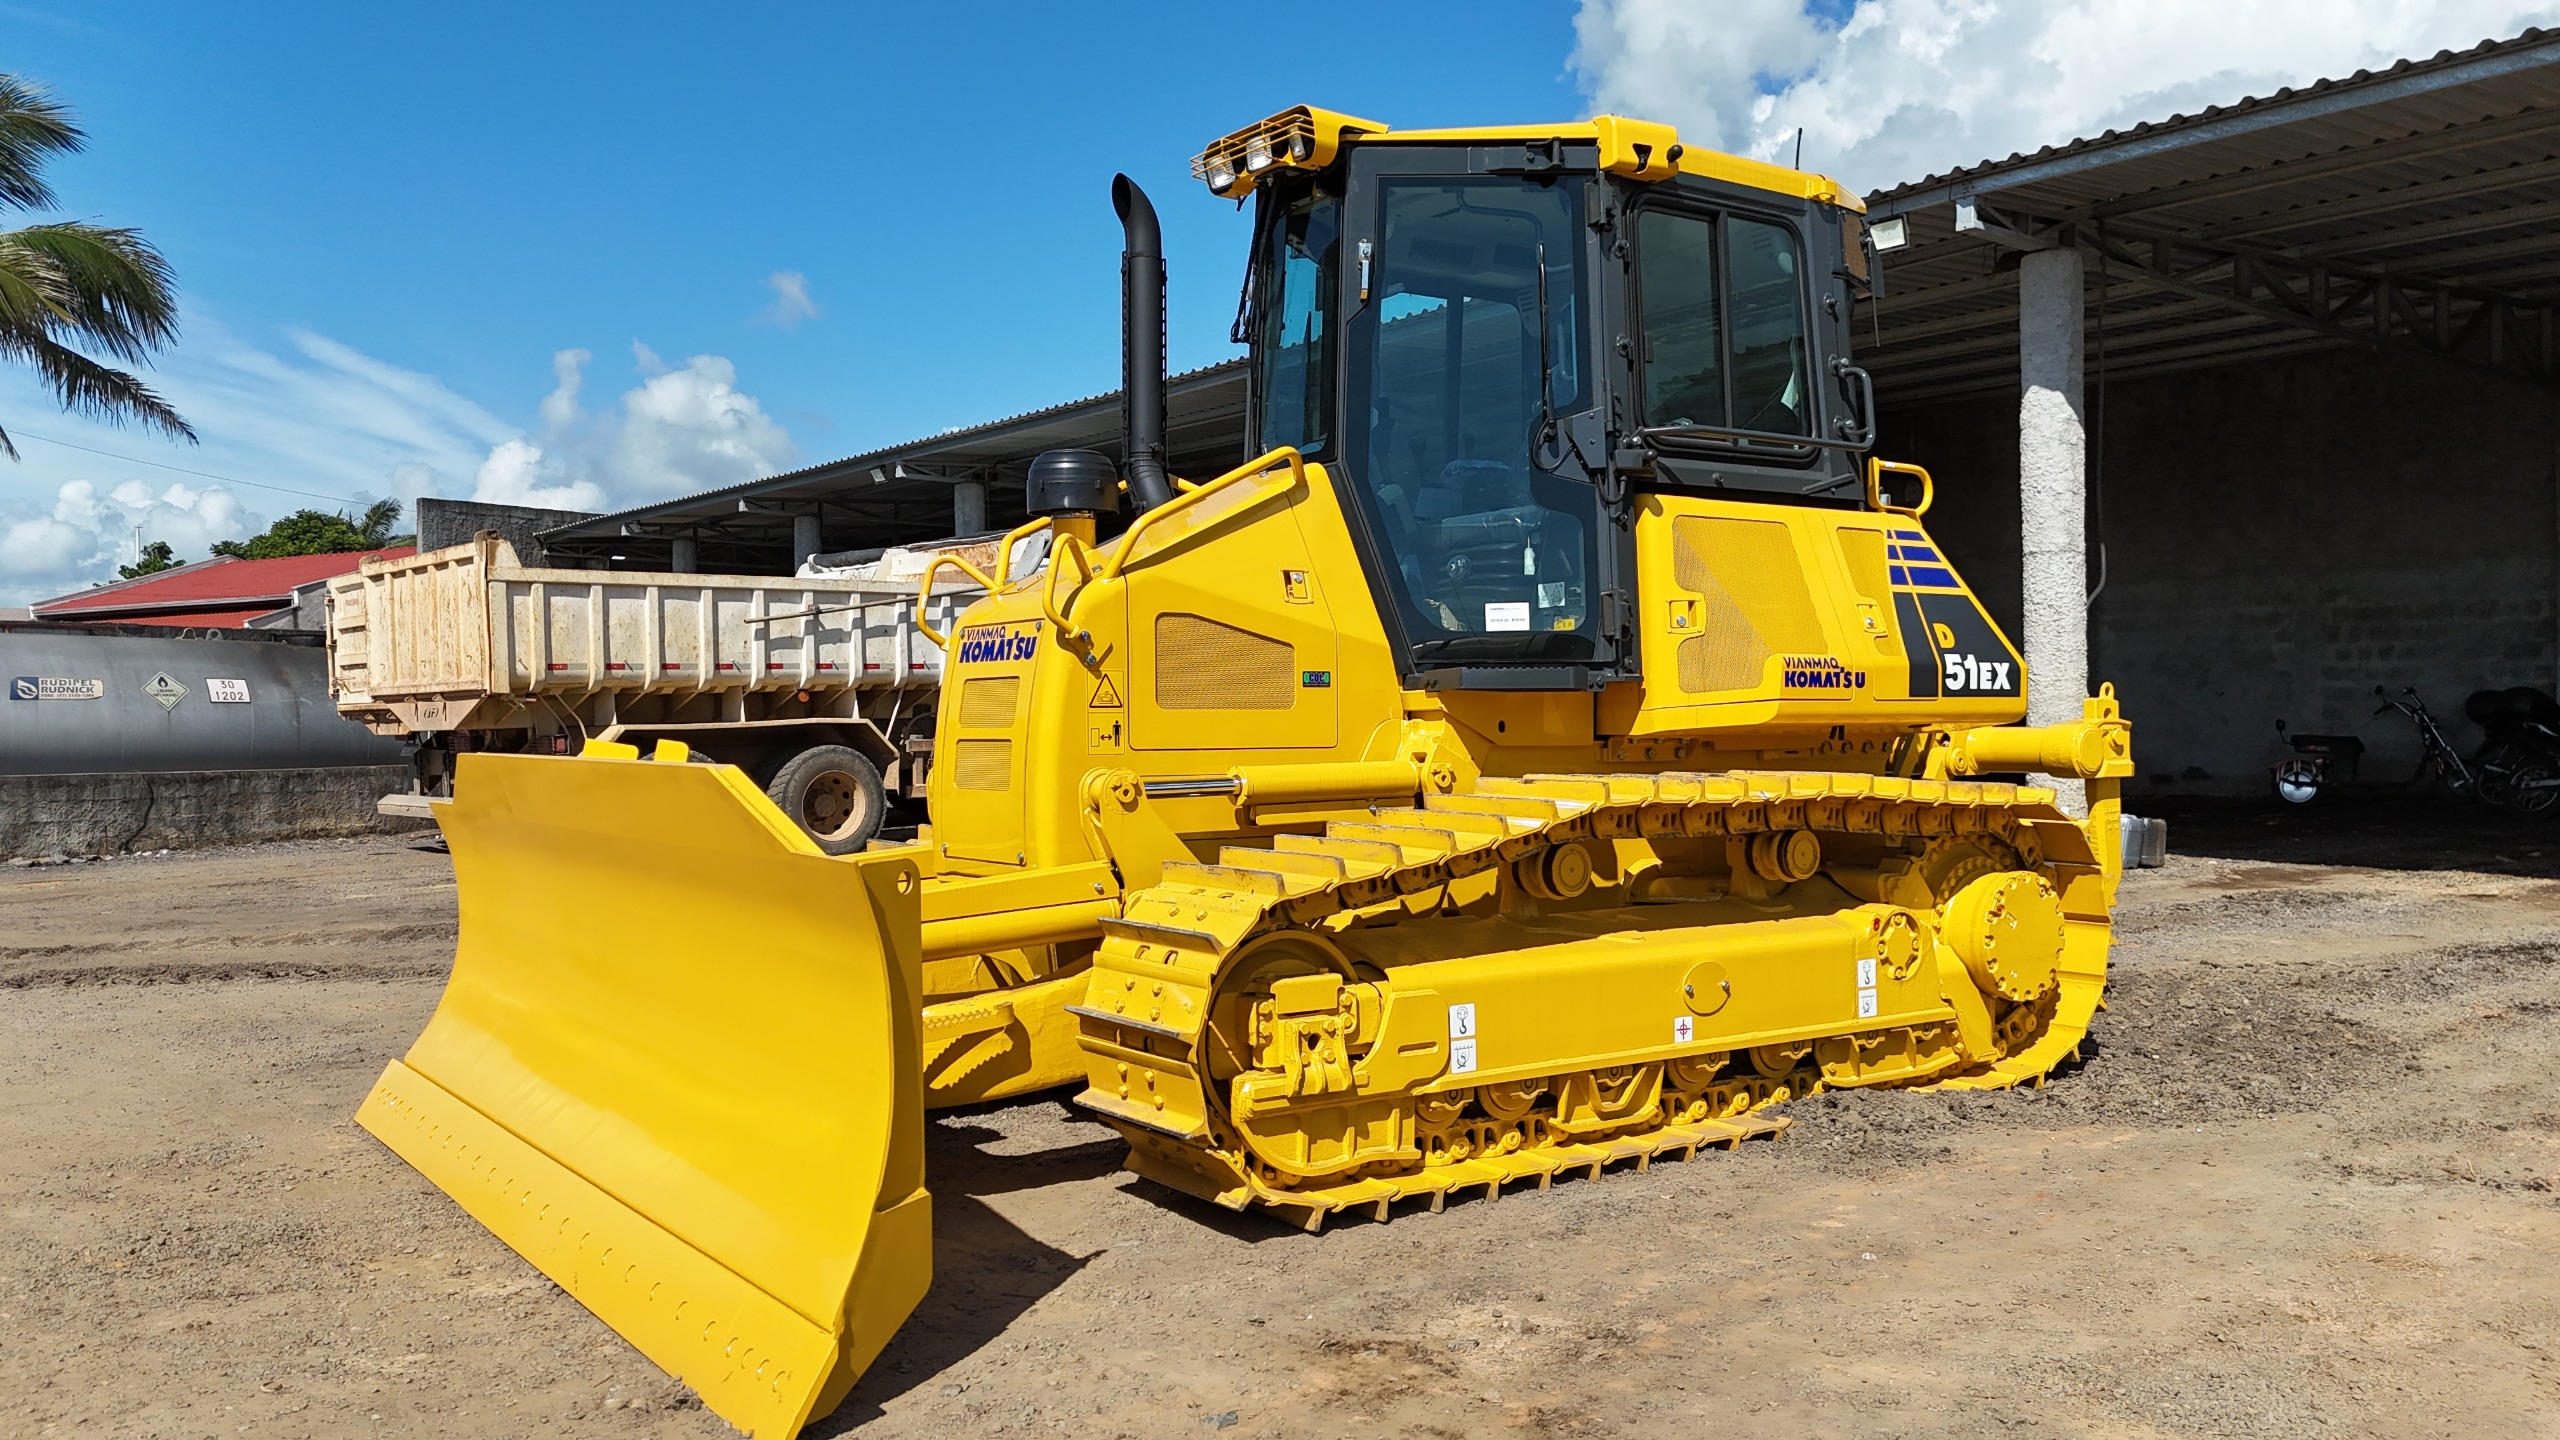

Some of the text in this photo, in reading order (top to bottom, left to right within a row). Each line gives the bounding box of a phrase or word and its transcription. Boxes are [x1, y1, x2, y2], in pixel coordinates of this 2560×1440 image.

[967, 626, 1006, 641] VIANMAQ
[1932, 623, 1955, 649] D
[959, 631, 1037, 663] KOMATSU
[1783, 657, 1840, 669] VIANMAQ
[1784, 666, 1866, 688] KOMATSU
[1943, 653, 2011, 690] 51EX
[41, 679, 95, 687] RUDIPEL
[220, 680, 235, 689] 30
[41, 686, 95, 694] RUDNICK
[215, 691, 245, 701] 1202
